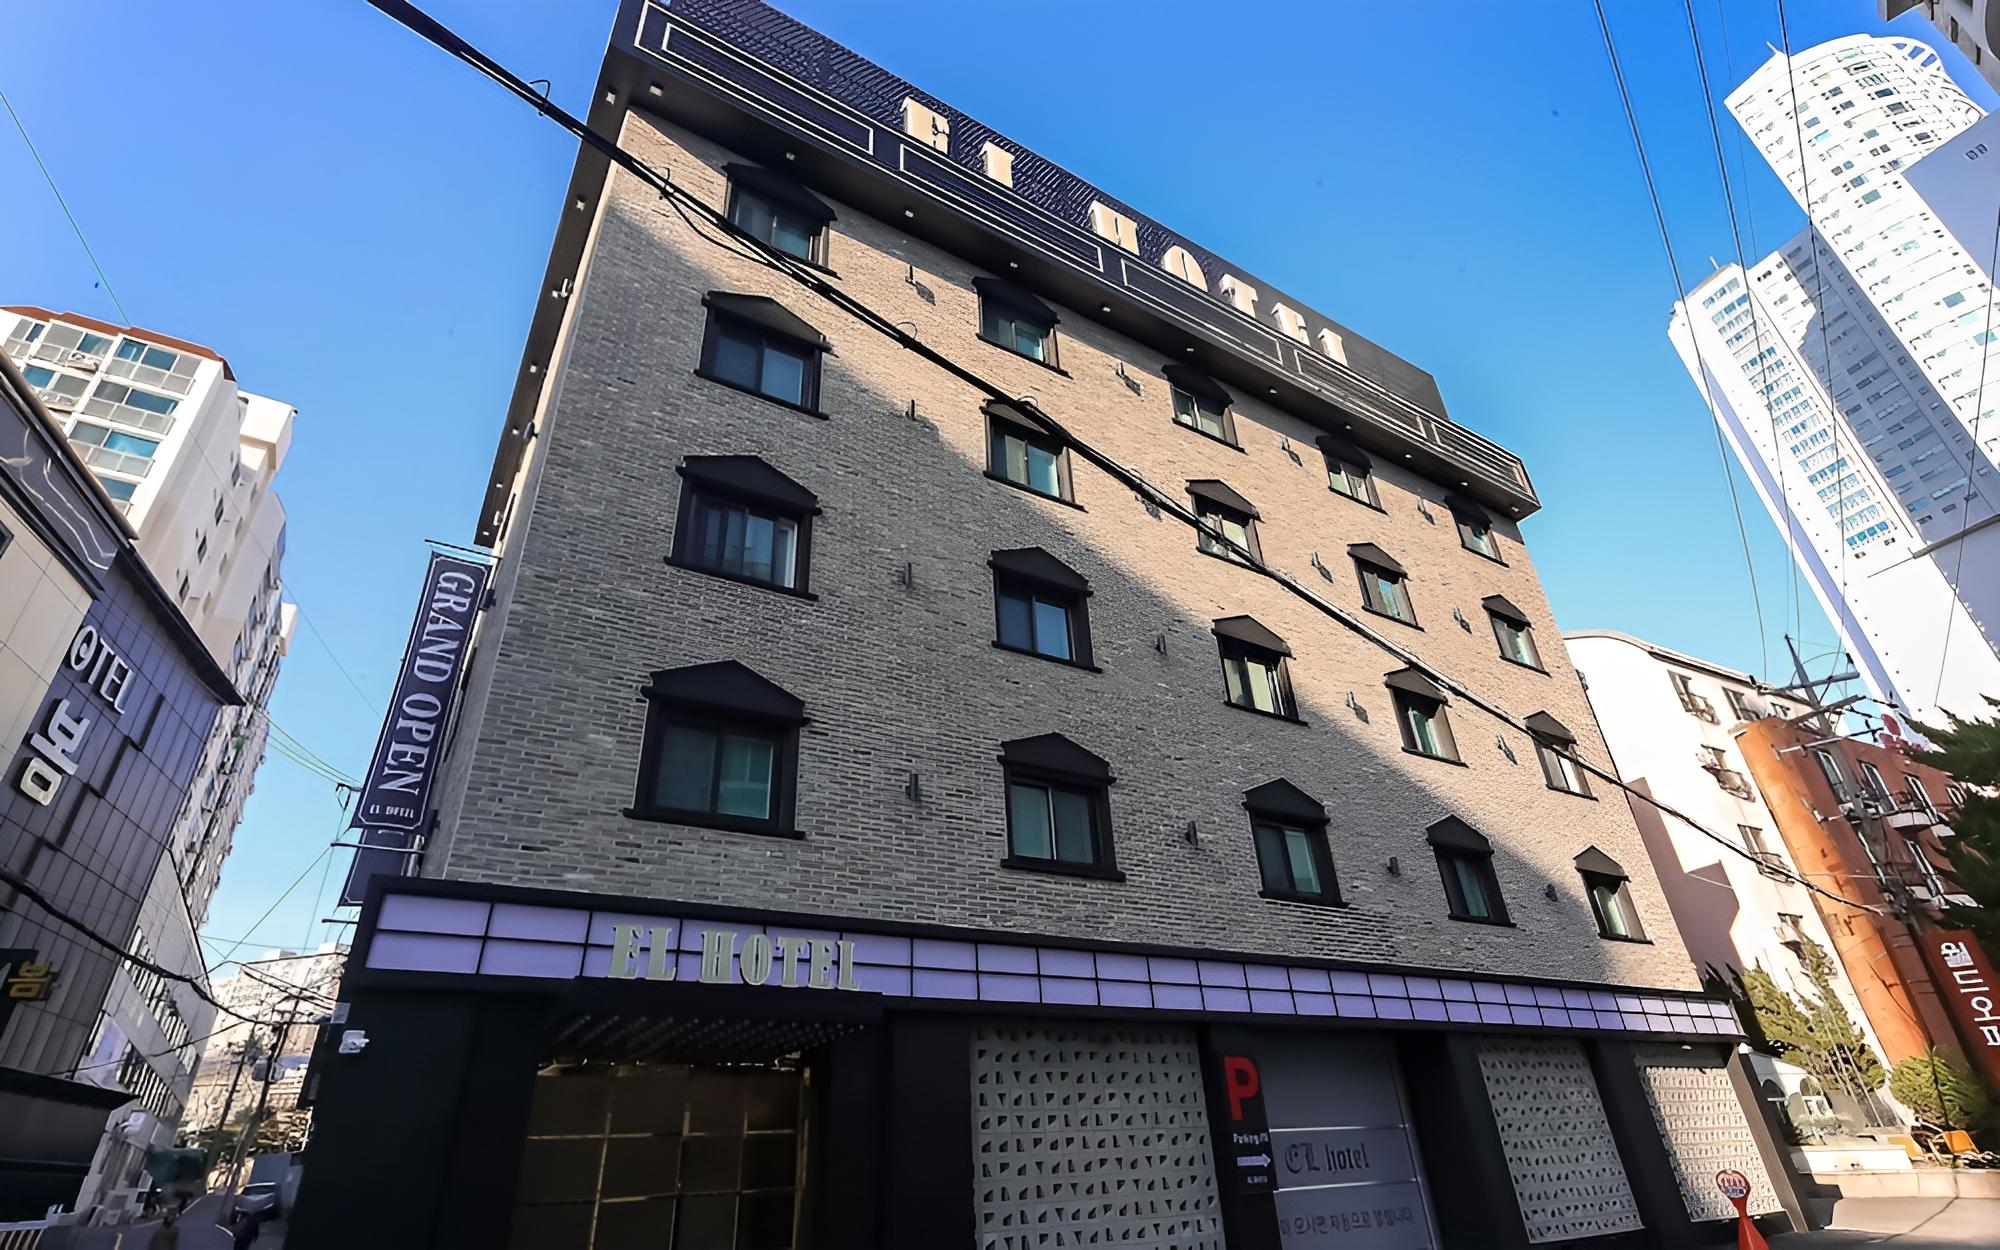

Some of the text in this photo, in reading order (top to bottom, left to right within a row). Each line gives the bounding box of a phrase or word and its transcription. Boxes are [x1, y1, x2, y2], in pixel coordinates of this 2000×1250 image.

[413, 570, 476, 683] GRAND
[377, 692, 442, 796] OPEN
[607, 923, 861, 992] EL HOTEL
[1224, 1056, 1259, 1120] P
